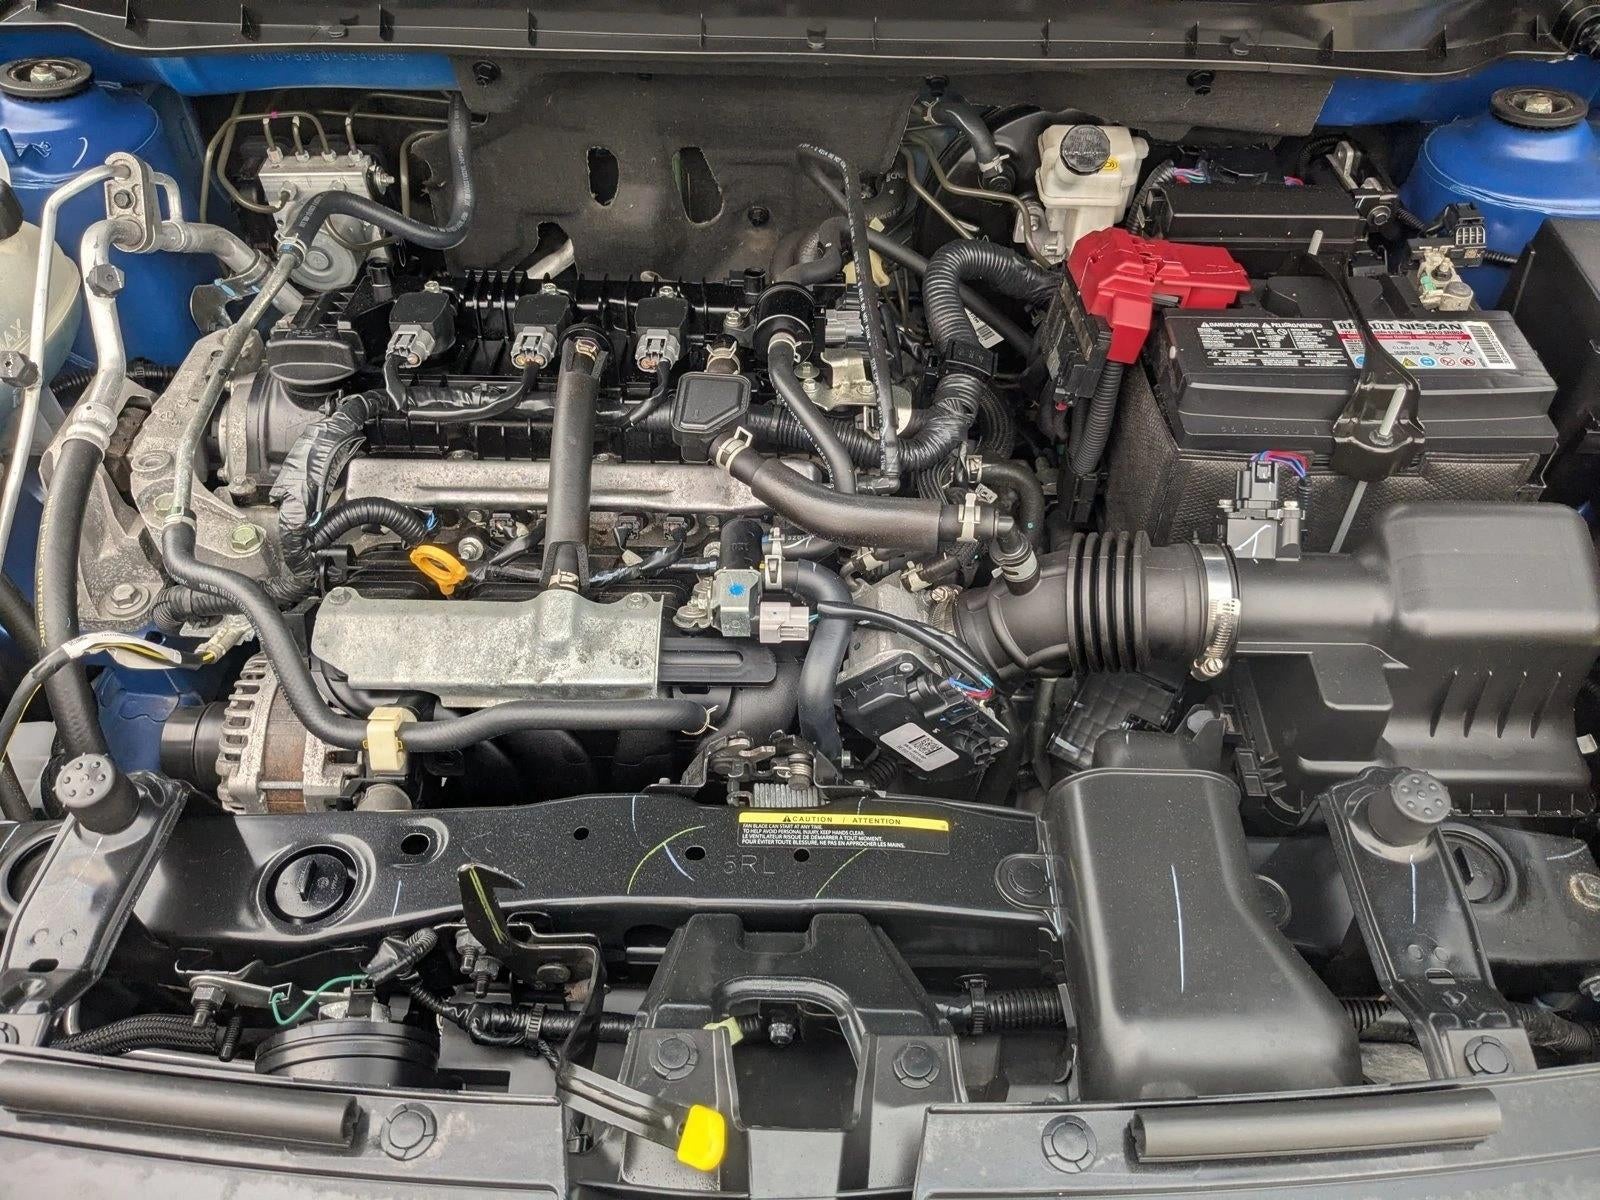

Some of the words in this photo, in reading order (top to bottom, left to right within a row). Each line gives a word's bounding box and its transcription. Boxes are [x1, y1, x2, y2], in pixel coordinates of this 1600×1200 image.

[1398, 322, 1463, 331] NISSAN
[792, 815, 833, 823] CAUTION
[852, 817, 901, 825] ATTENTION
